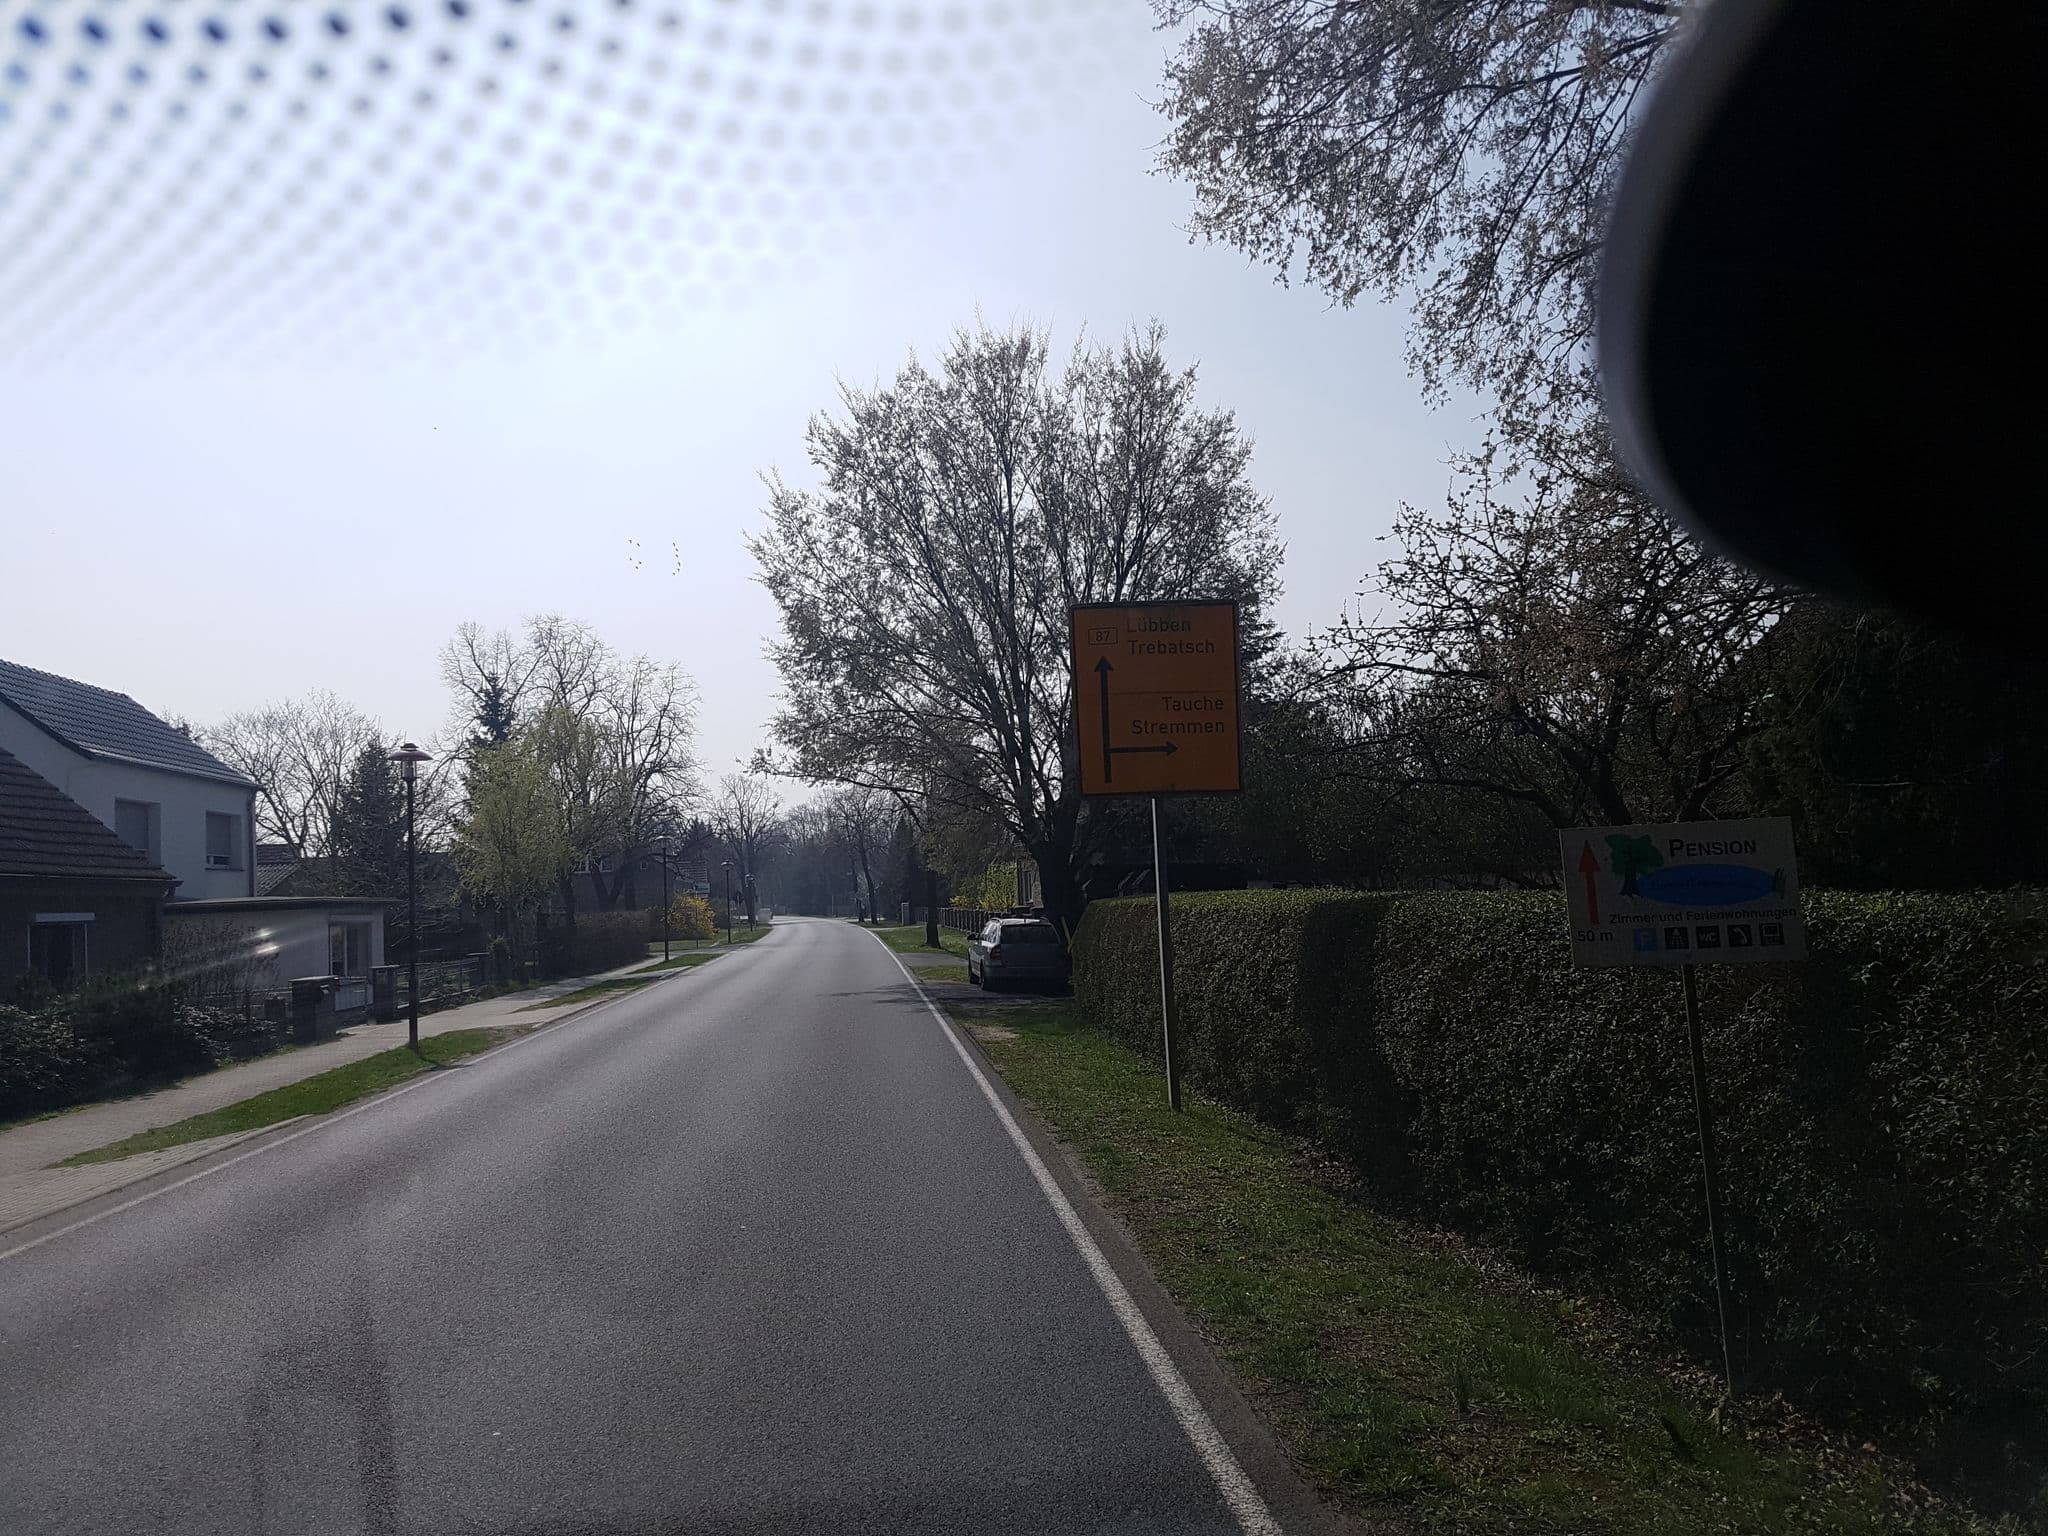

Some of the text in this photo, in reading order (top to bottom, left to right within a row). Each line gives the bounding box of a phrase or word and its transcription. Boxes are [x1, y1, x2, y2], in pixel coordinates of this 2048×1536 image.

[1127, 616, 1191, 633] Lübben
[1095, 630, 1110, 642] 87
[1128, 640, 1215, 655] Trebatsch
[1162, 696, 1224, 711] Tauche
[1132, 720, 1225, 734] Stremmen
[1669, 838, 1756, 857] PENSION
[1610, 908, 1797, 924] Zimmer und Ferienwohnungen
[1577, 930, 1613, 942] 50 m
